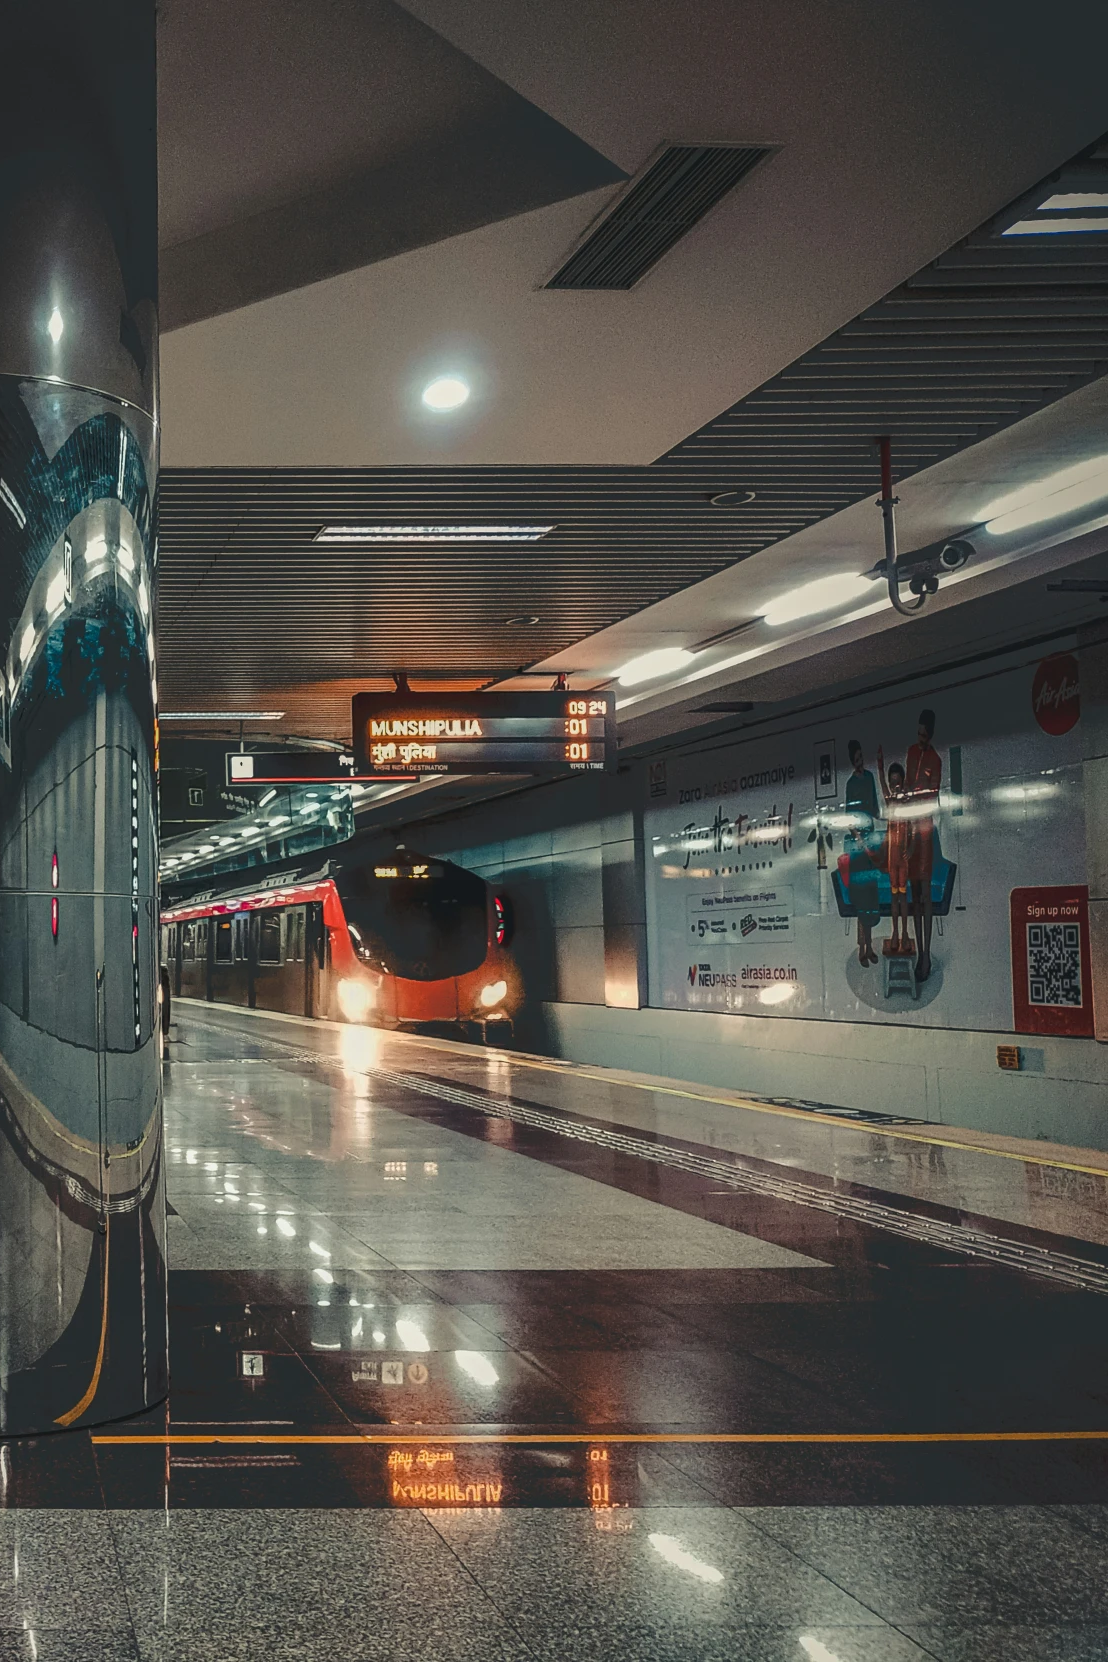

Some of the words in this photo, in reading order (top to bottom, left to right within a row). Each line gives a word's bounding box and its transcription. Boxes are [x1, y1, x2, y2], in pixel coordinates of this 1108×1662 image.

[1035, 676, 1080, 712] AirAsia
[371, 719, 483, 737] MUNSHIPULIA
[1027, 905, 1046, 917] Sign
[1047, 907, 1058, 917] up
[1060, 906, 1079, 914] now
[741, 964, 798, 981] airasia.co.in
